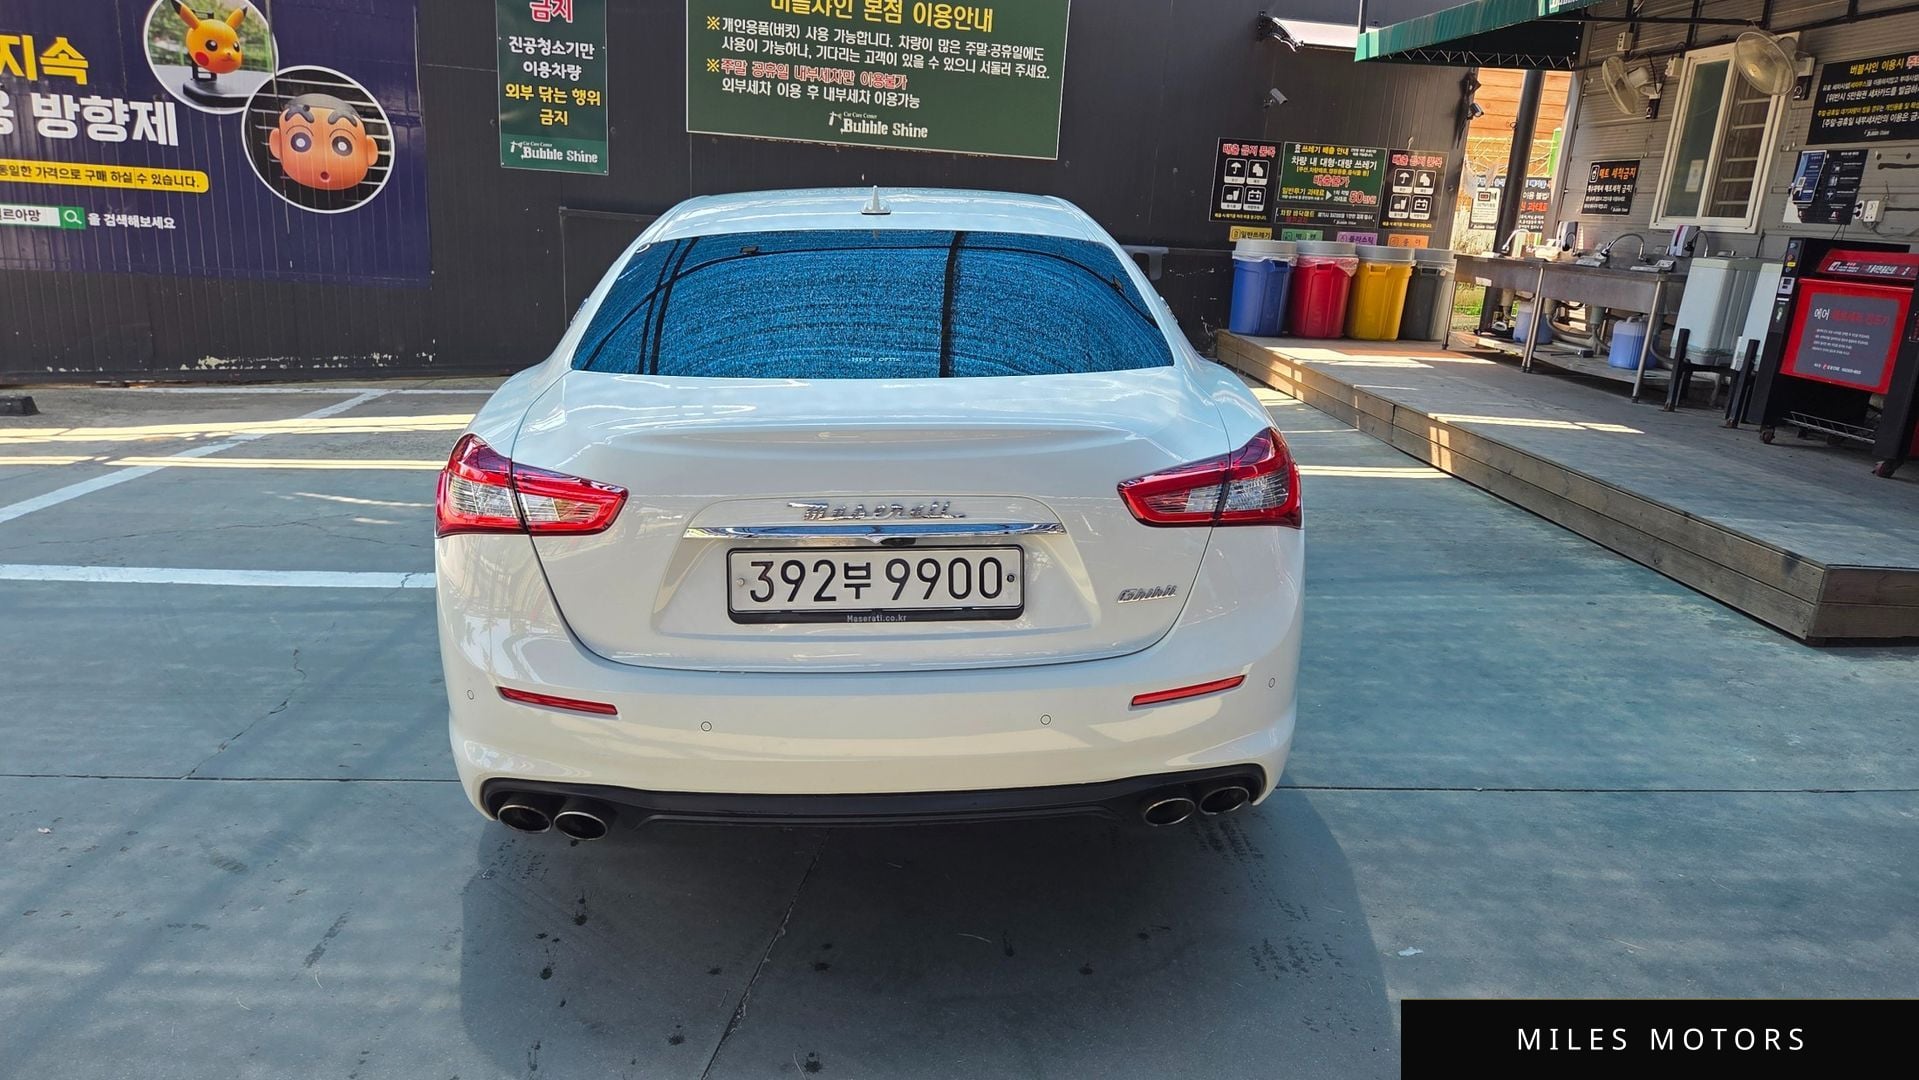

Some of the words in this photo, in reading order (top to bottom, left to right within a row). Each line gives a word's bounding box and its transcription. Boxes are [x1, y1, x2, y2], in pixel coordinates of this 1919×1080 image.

[913, 2, 993, 32] 이용안내
[508, 36, 595, 59] 진공청소기만
[805, 26, 829, 42] 사용
[834, 28, 893, 48] 가능합니다.
[898, 34, 933, 52] 차량이
[938, 38, 960, 54] 많은
[722, 37, 758, 53] 사용이
[762, 40, 812, 59] 가능하나,
[816, 44, 860, 63] 기다리는
[864, 48, 897, 66] 고객이
[902, 53, 924, 69] 있을
[928, 55, 939, 70] 수
[943, 57, 976, 73] 있으니
[979, 59, 1011, 76] 서둘러
[1015, 63, 1050, 79] 주세요.
[1850, 61, 1879, 75] 버블샤인
[1881, 58, 1905, 71] 이용시
[523, 61, 582, 82] 이용차량
[752, 61, 789, 79] 공휴일
[794, 65, 855, 86] 내부세차만
[860, 71, 907, 91] 이용불가
[505, 83, 534, 101] 외부
[538, 86, 568, 104] 닦는
[571, 88, 601, 106] 행위
[722, 78, 771, 96] 외부세차
[777, 82, 801, 99] 이용
[807, 85, 819, 100] 후
[823, 87, 871, 105] 내부세차
[874, 91, 920, 109] 이용가능
[31, 92, 178, 146] 방향제
[539, 109, 569, 126] 금지
[840, 118, 888, 135] Bubble
[892, 122, 928, 138] Shine
[521, 147, 563, 161] Bubble
[566, 150, 598, 163] Shine
[1301, 145, 1321, 155] 쓰레기
[1291, 155, 1308, 166] 차량
[1354, 160, 1377, 171] 쓰레기
[36, 166, 81, 180] 가격으로
[85, 169, 107, 182] 구매
[111, 171, 133, 184] 하실
[137, 173, 148, 184] 수
[151, 174, 200, 188] 있습니다.
[0, 207, 41, 222] 르아망
[104, 213, 176, 229] 검색해보세요
[1814, 307, 1830, 321] 에어
[787, 501, 966, 521] Maserati
[750, 559, 872, 602] 392부
[885, 557, 1003, 601] 9900
[1118, 584, 1177, 603] Ghibli
[847, 614, 907, 623] Maserati.co.kr
